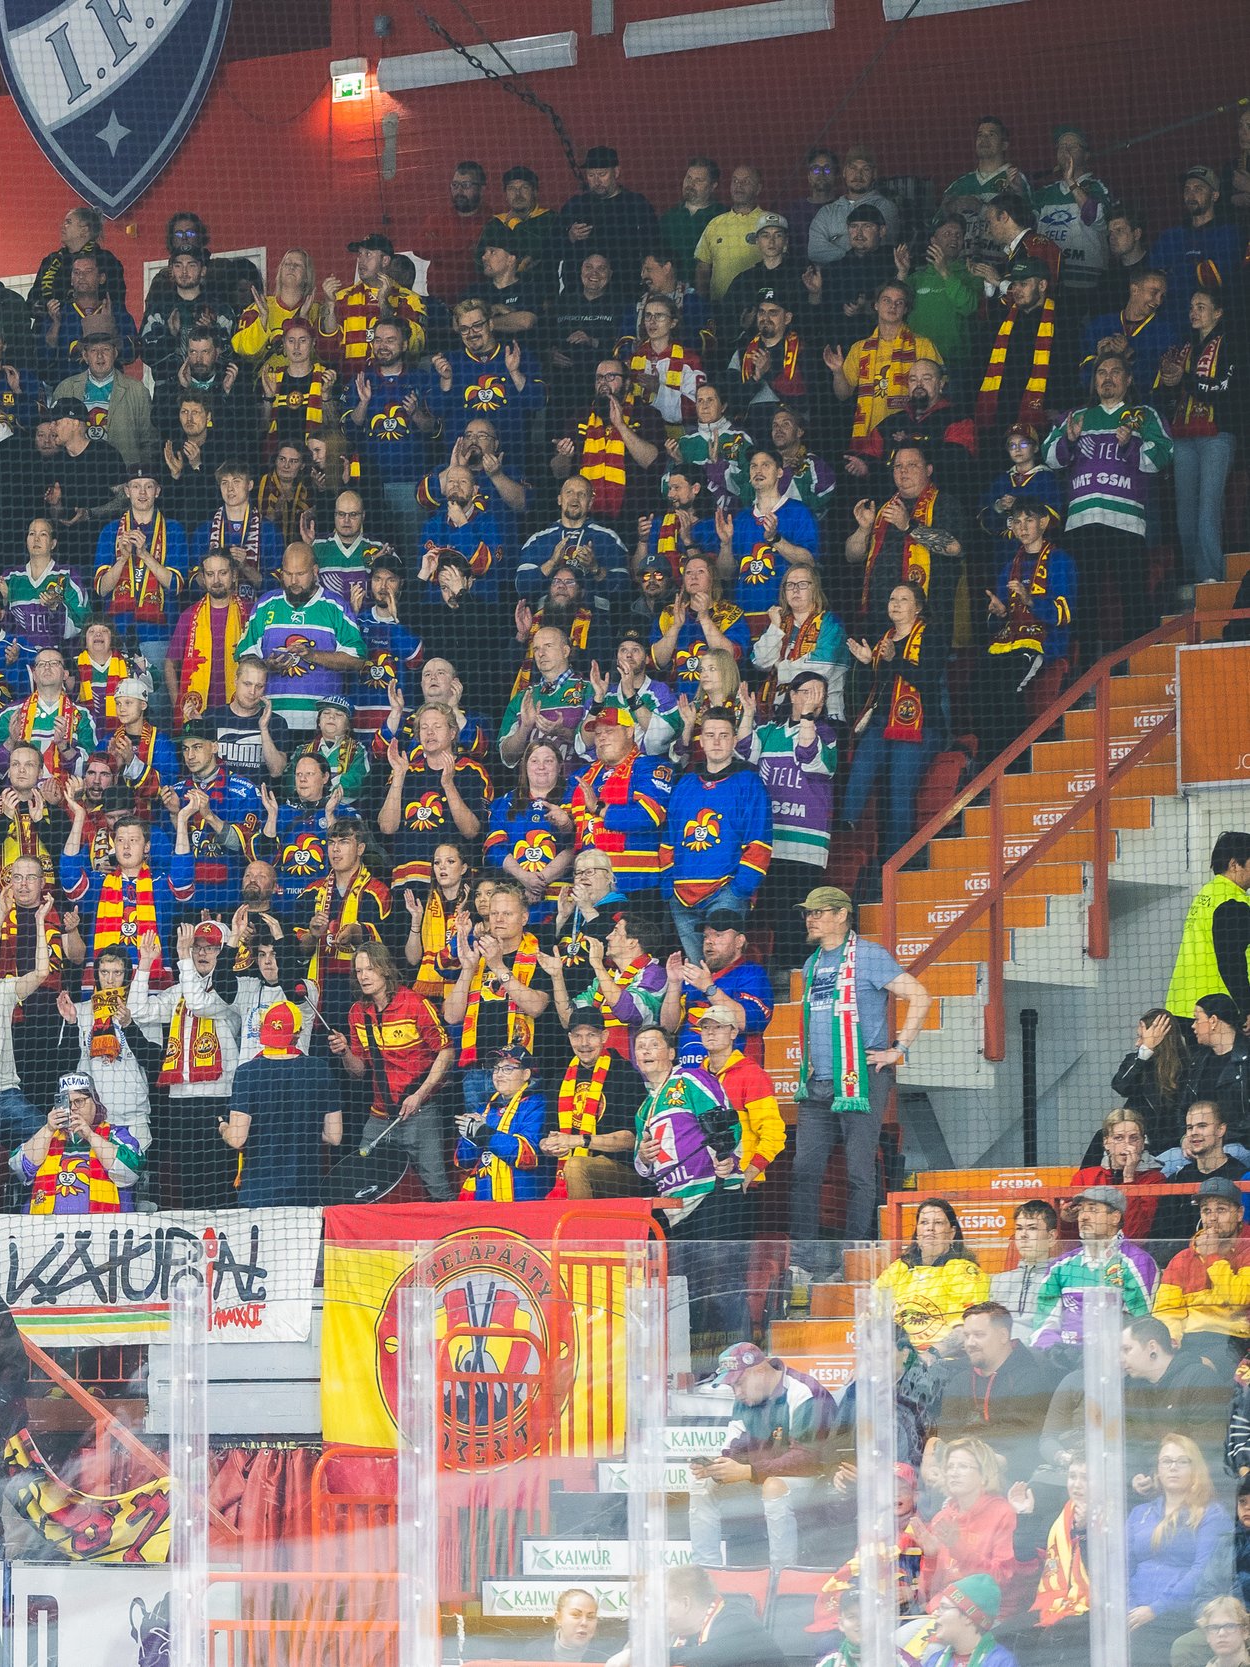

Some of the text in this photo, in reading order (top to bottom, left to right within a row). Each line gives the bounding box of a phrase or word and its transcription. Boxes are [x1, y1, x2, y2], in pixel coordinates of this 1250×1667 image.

[1096, 473, 1131, 489] GSM
[771, 766, 803, 789] TELE
[555, 1550, 612, 1566] KAIWUR
